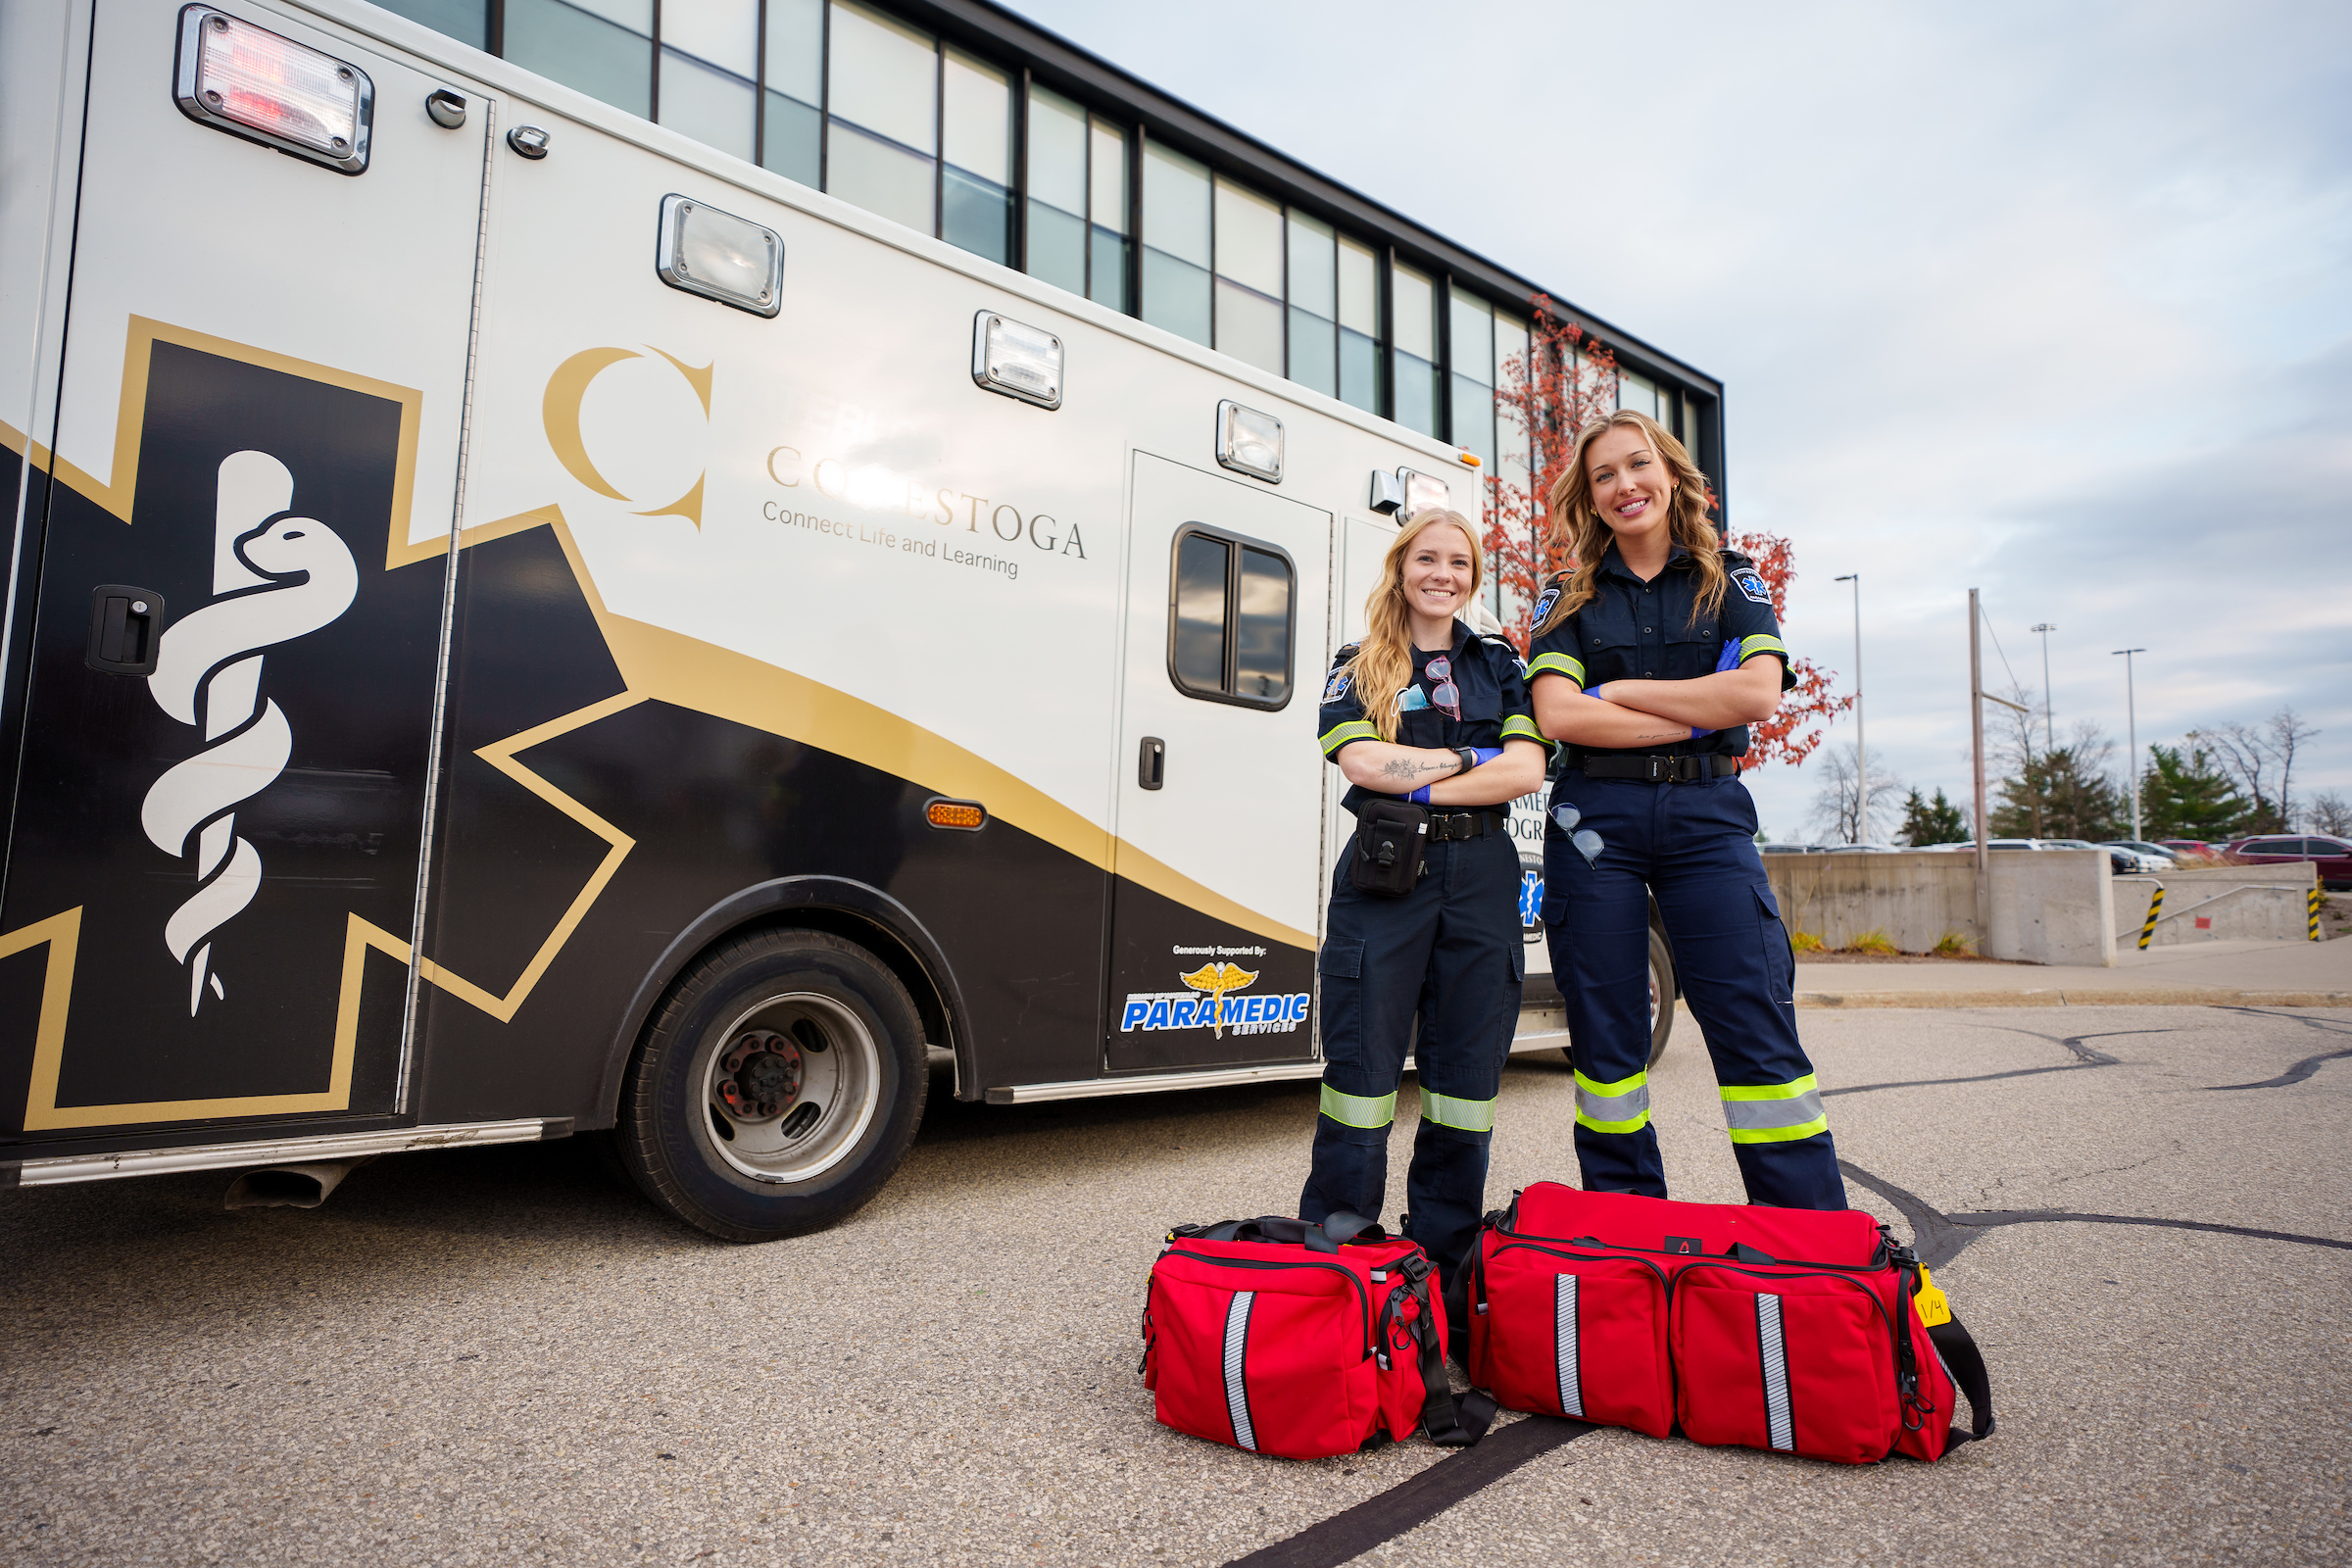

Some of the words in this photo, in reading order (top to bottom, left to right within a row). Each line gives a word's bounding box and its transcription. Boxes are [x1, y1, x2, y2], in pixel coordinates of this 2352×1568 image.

[766, 445, 1088, 561] COESTOGA
[762, 501, 854, 539] Connect
[859, 522, 896, 548] Life
[902, 539, 936, 558] and
[943, 542, 1018, 580] Learning
[1172, 945, 1215, 956] Generously
[1216, 945, 1253, 956] Supported
[1254, 946, 1267, 956] By:
[1121, 994, 1310, 1032] PARAMEDIC
[1231, 1022, 1298, 1036] SERVICES
[1921, 1299, 1944, 1319] 1/4
